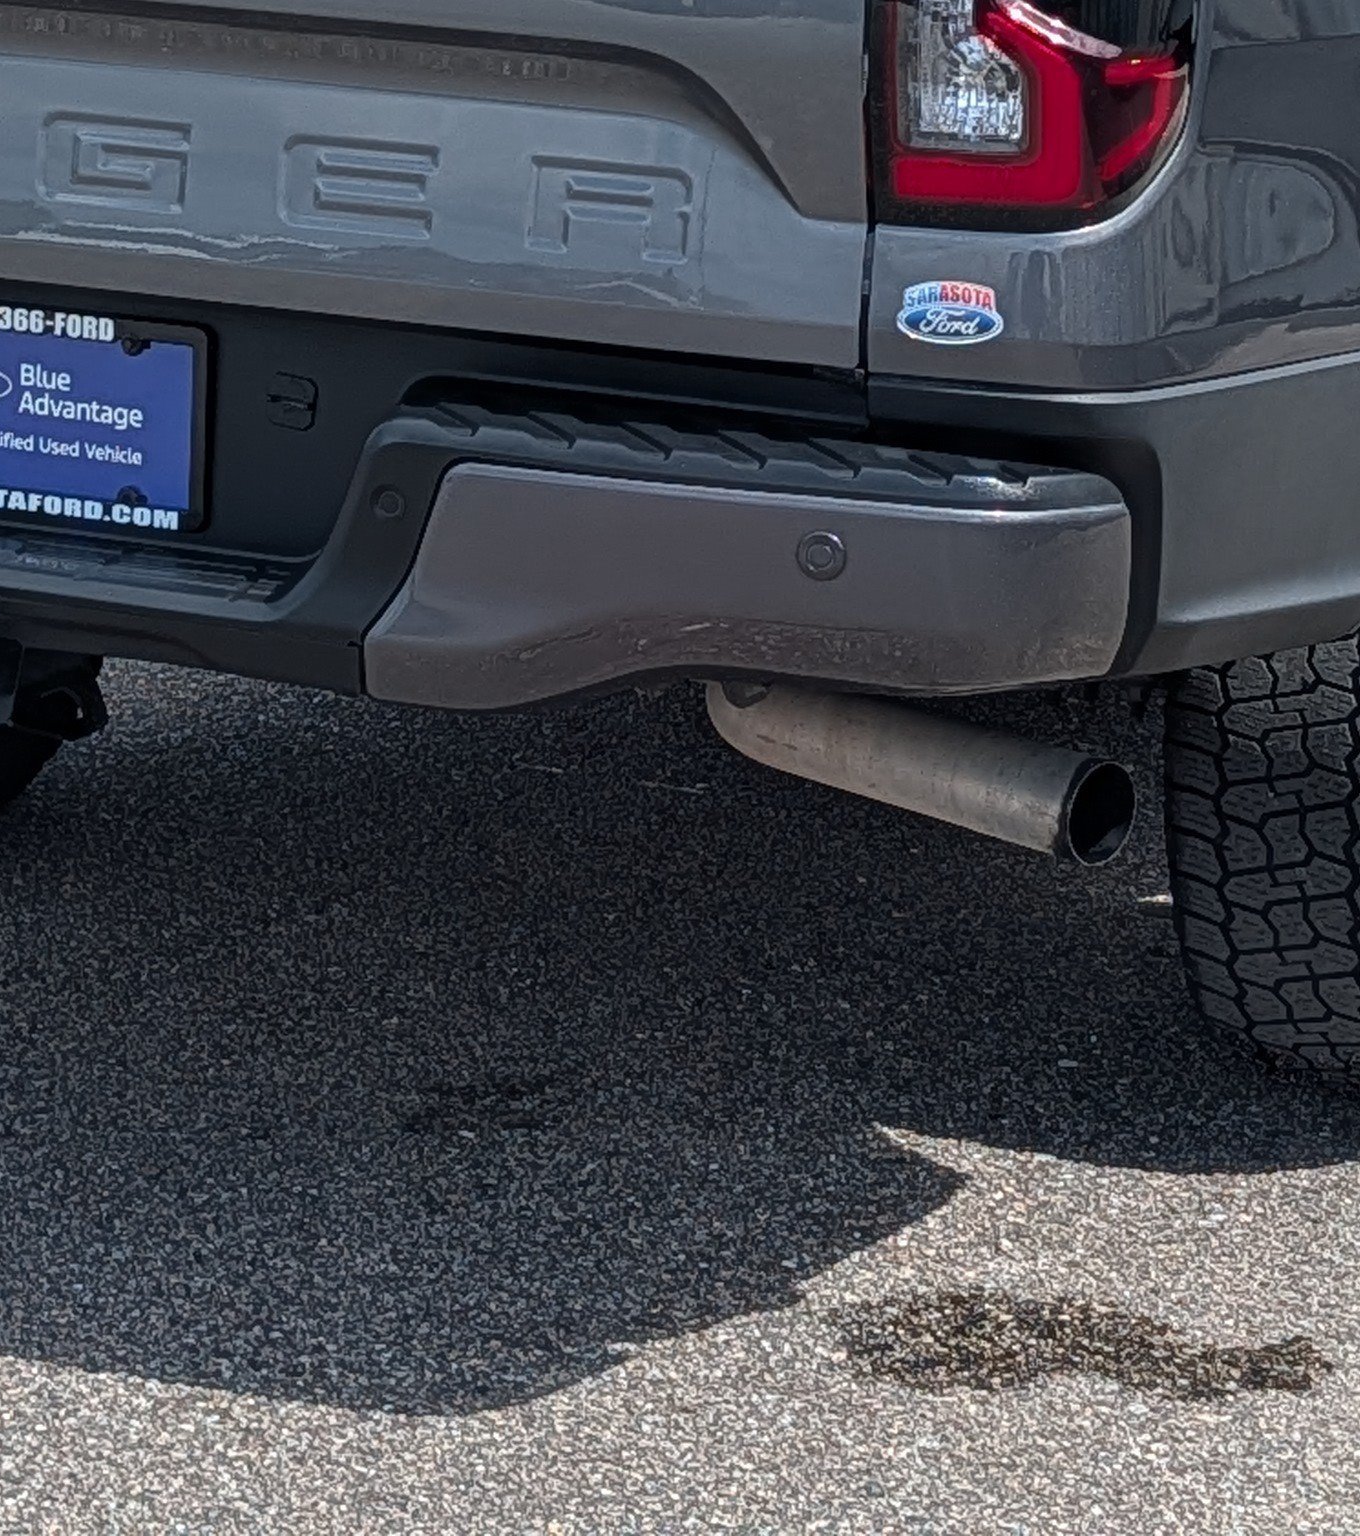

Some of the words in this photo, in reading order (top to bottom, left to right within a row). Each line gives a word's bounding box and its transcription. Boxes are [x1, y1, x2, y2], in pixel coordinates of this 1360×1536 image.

[904, 284, 993, 310] SARASOTA
[919, 308, 981, 335] Ford
[19, 363, 72, 392] Blue
[18, 391, 144, 430] Advantage
[39, 438, 80, 458] Used
[84, 442, 143, 466] Vehicle
